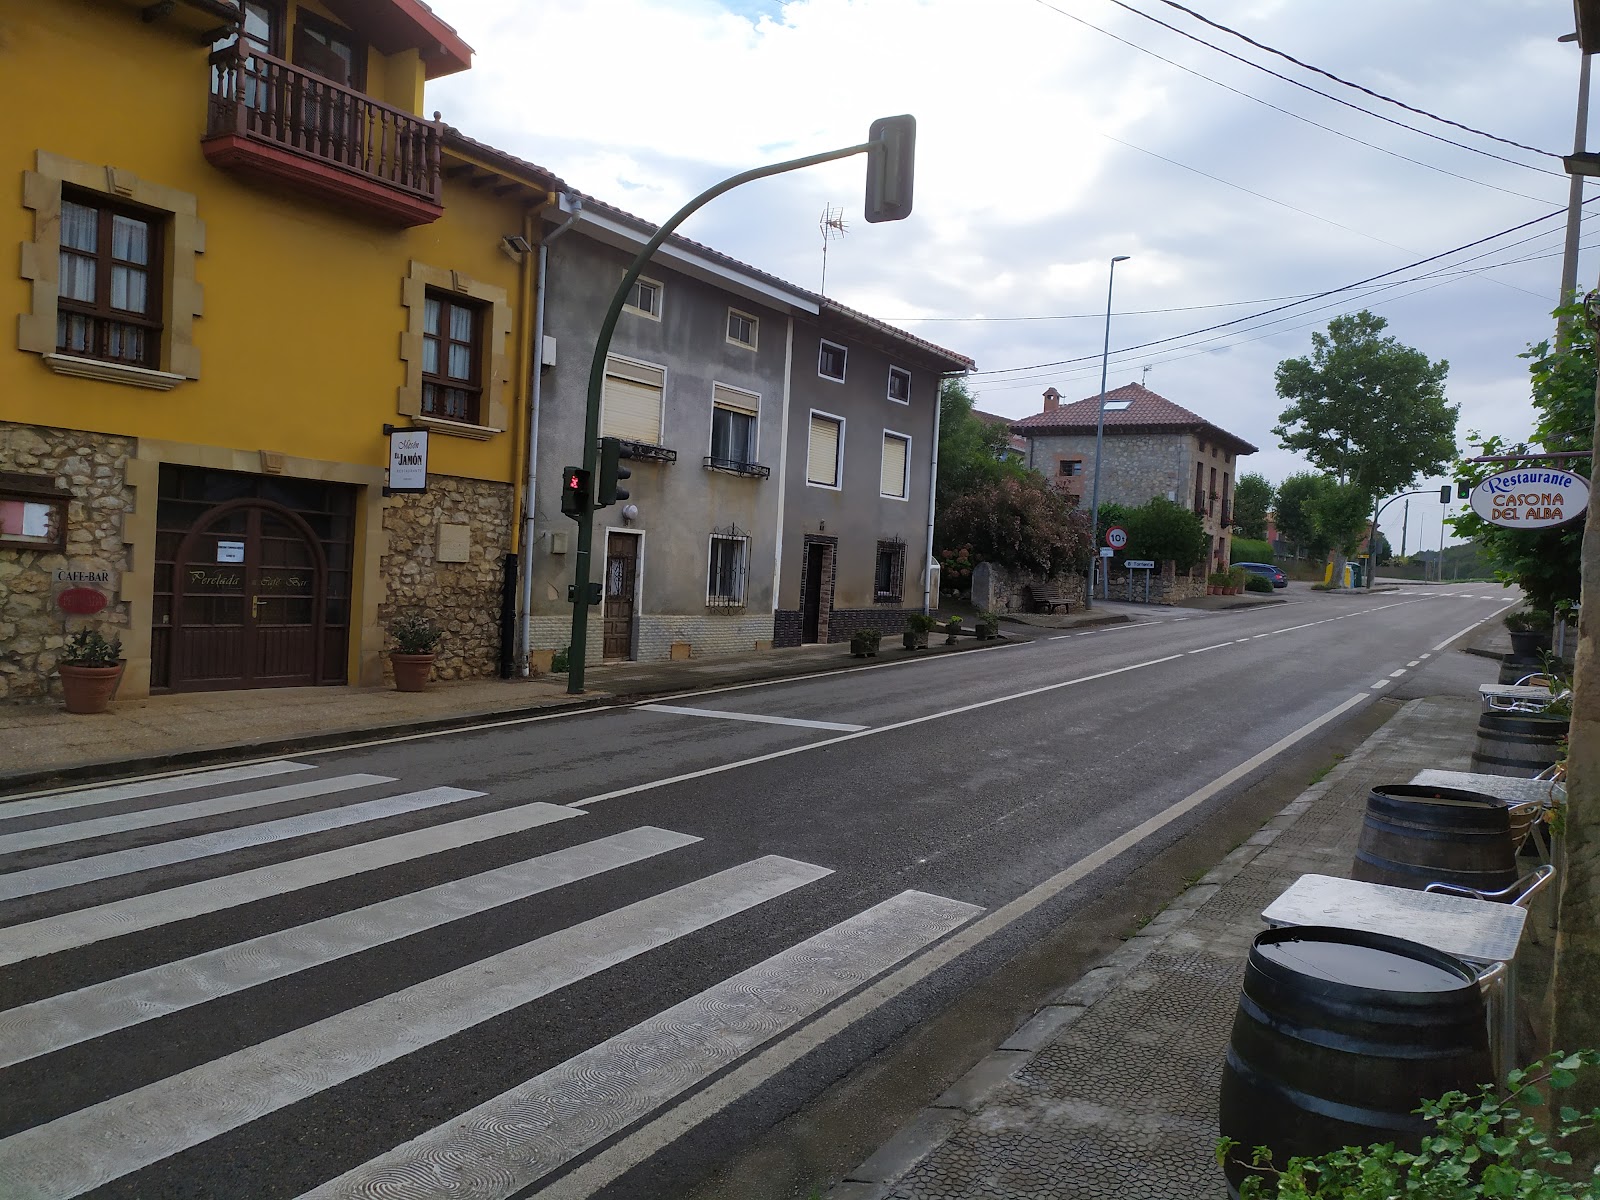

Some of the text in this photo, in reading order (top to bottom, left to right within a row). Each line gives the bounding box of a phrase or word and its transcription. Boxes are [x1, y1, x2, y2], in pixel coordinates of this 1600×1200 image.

[398, 452, 423, 466] JAMÓN
[1482, 473, 1572, 494] Restaurante
[1493, 493, 1564, 506] CASONA
[1492, 507, 1563, 520] DEL ALBA
[58, 571, 109, 582] CAFE-BAR
